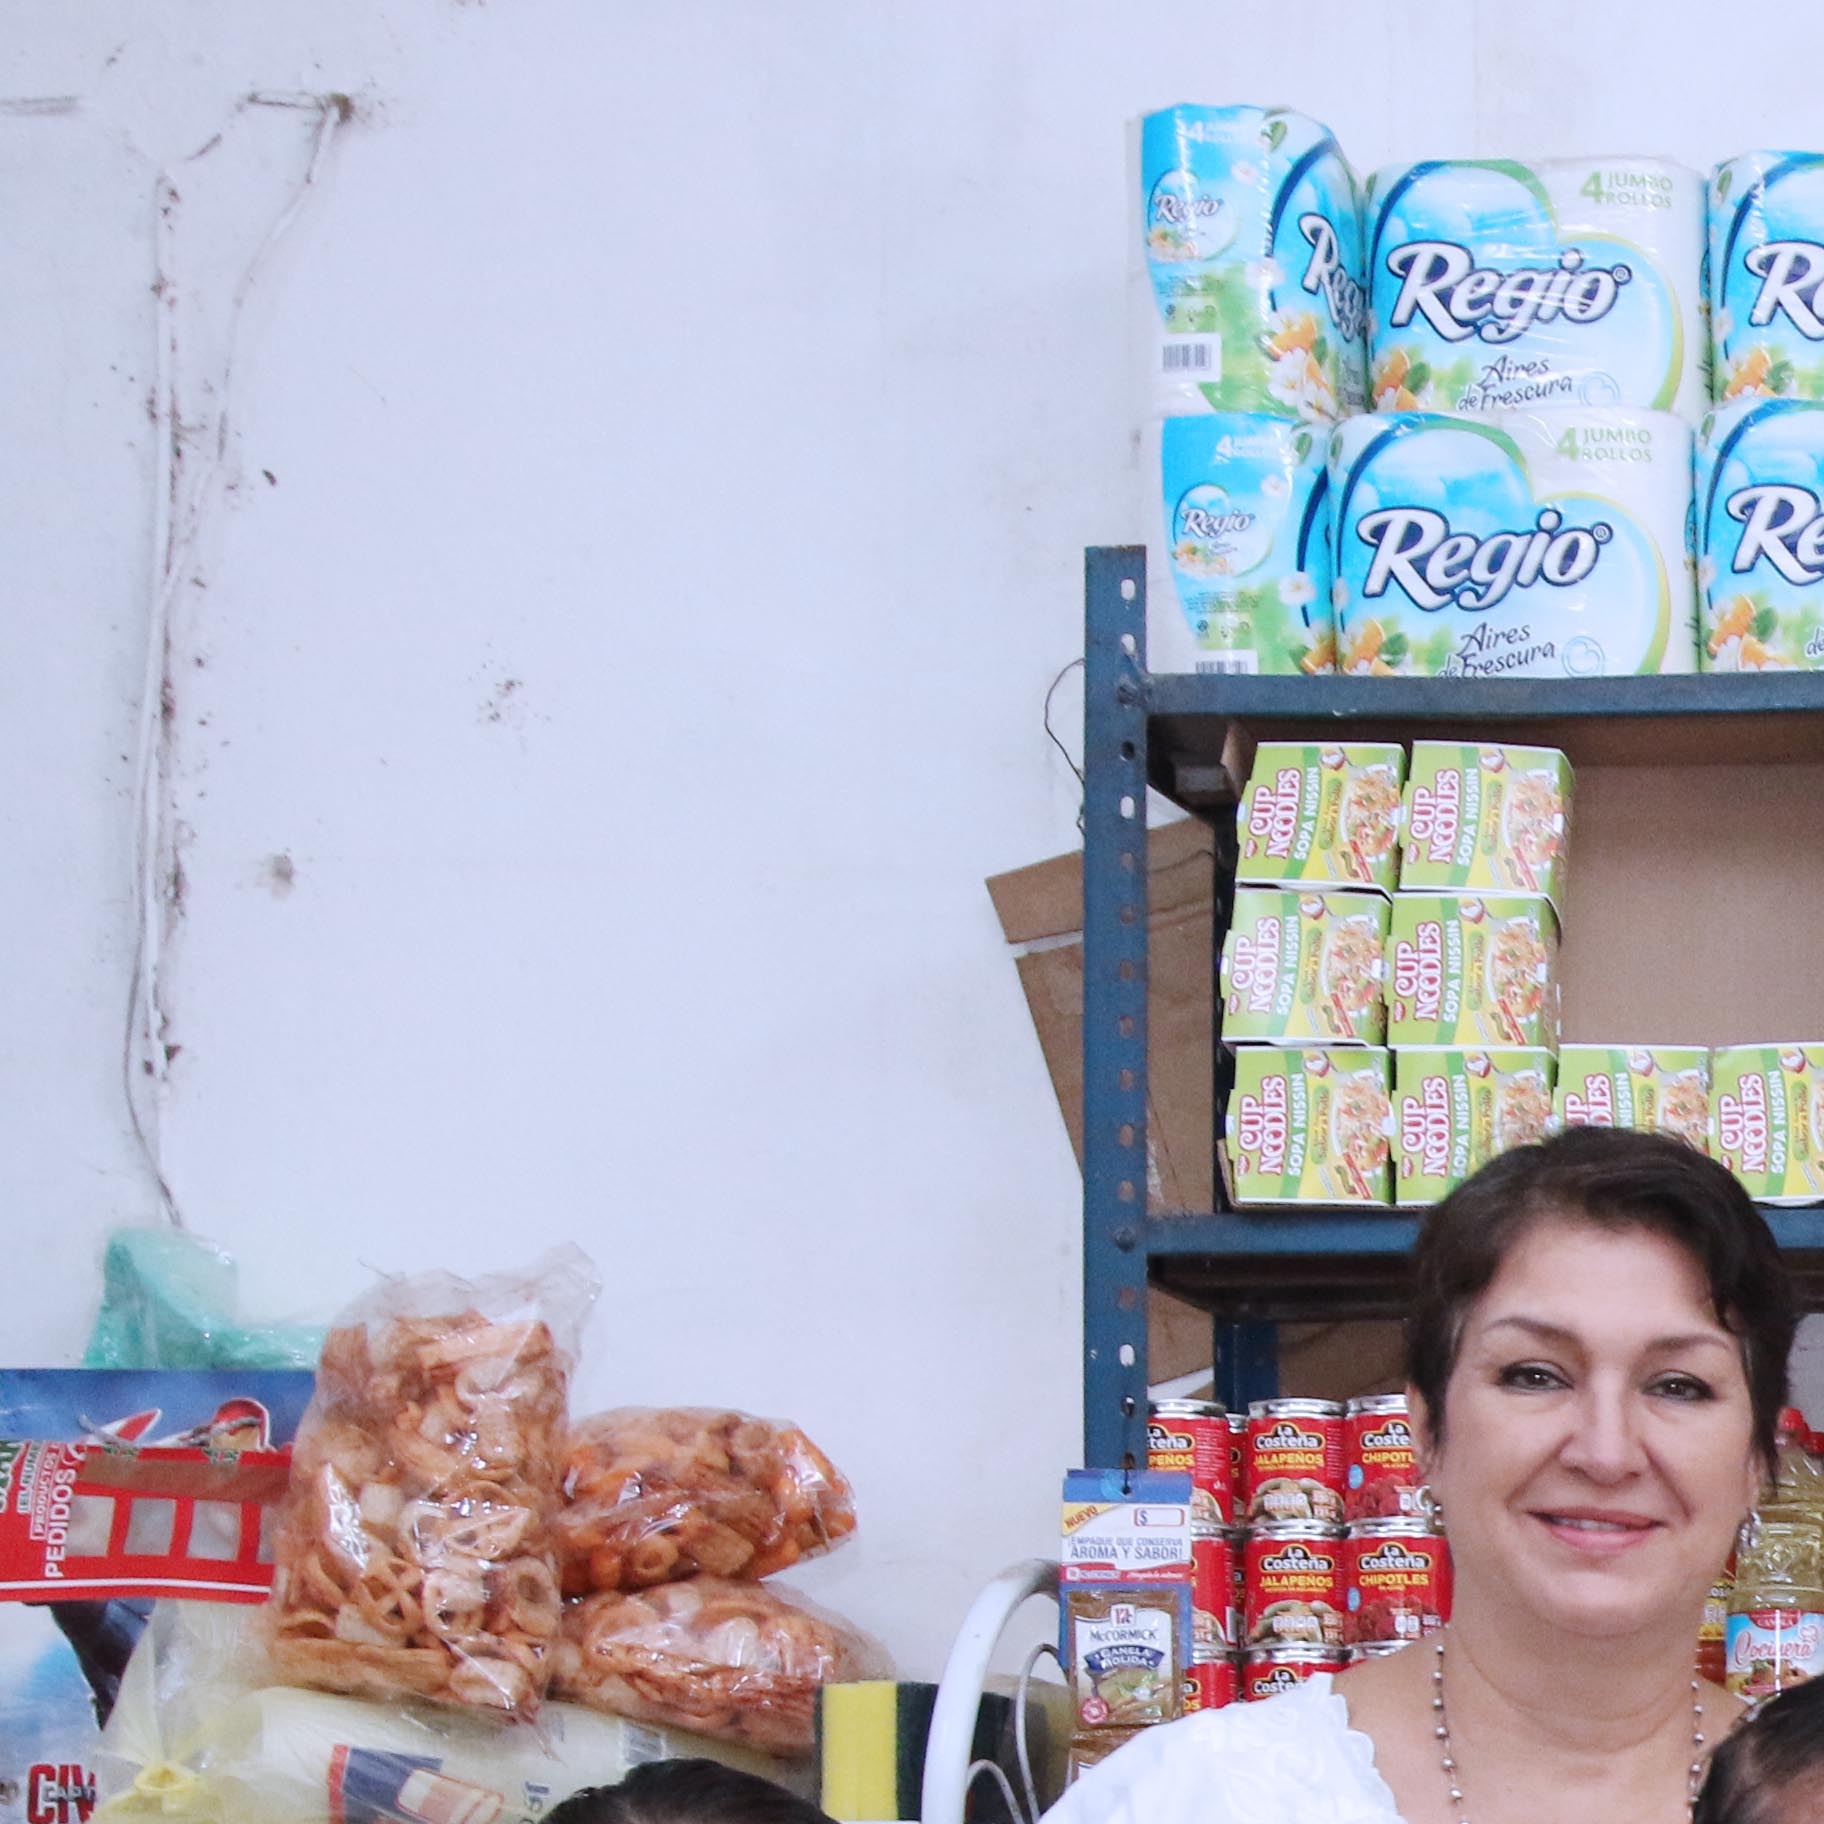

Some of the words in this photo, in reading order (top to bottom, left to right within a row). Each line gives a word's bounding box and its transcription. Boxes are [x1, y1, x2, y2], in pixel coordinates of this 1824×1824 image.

[1154, 190, 1220, 223] Regio
[1386, 239, 1617, 344] Regio
[1481, 355, 1550, 385] Aires
[1458, 388, 1478, 411] de
[1477, 373, 1573, 408] Frescura
[1555, 427, 1580, 459] 4
[1582, 427, 1652, 446] JUMBO
[1581, 445, 1653, 463] ROLLOS
[1180, 507, 1252, 536] Regio
[1356, 505, 1600, 611] Regio
[1457, 622, 1532, 658] Aires
[1457, 640, 1556, 679] Frescura
[1249, 785, 1273, 837] CUP
[1265, 768, 1302, 859] NOODLES
[1293, 821, 1316, 861] SOPA
[1305, 766, 1319, 817] NISSIN
[1409, 785, 1436, 843] CUP
[1427, 766, 1461, 866] NOODLES
[1455, 821, 1476, 868] SOPA
[1466, 766, 1480, 817] NISSIN
[44, 1468, 76, 1578] PEDIDOS
[1065, 1505, 1098, 1529] NUEVO
[1071, 1549, 1118, 1559] AROMA
[1124, 1549, 1130, 1559] Y
[1134, 1549, 1182, 1560] SABOR!
[1262, 1557, 1330, 1570] Costeña
[1287, 1548, 1302, 1559] La
[1360, 1554, 1426, 1568] Costeña
[1259, 1575, 1332, 1587] JALAPEÑOS
[1360, 1574, 1428, 1586] CHIPOTLES
